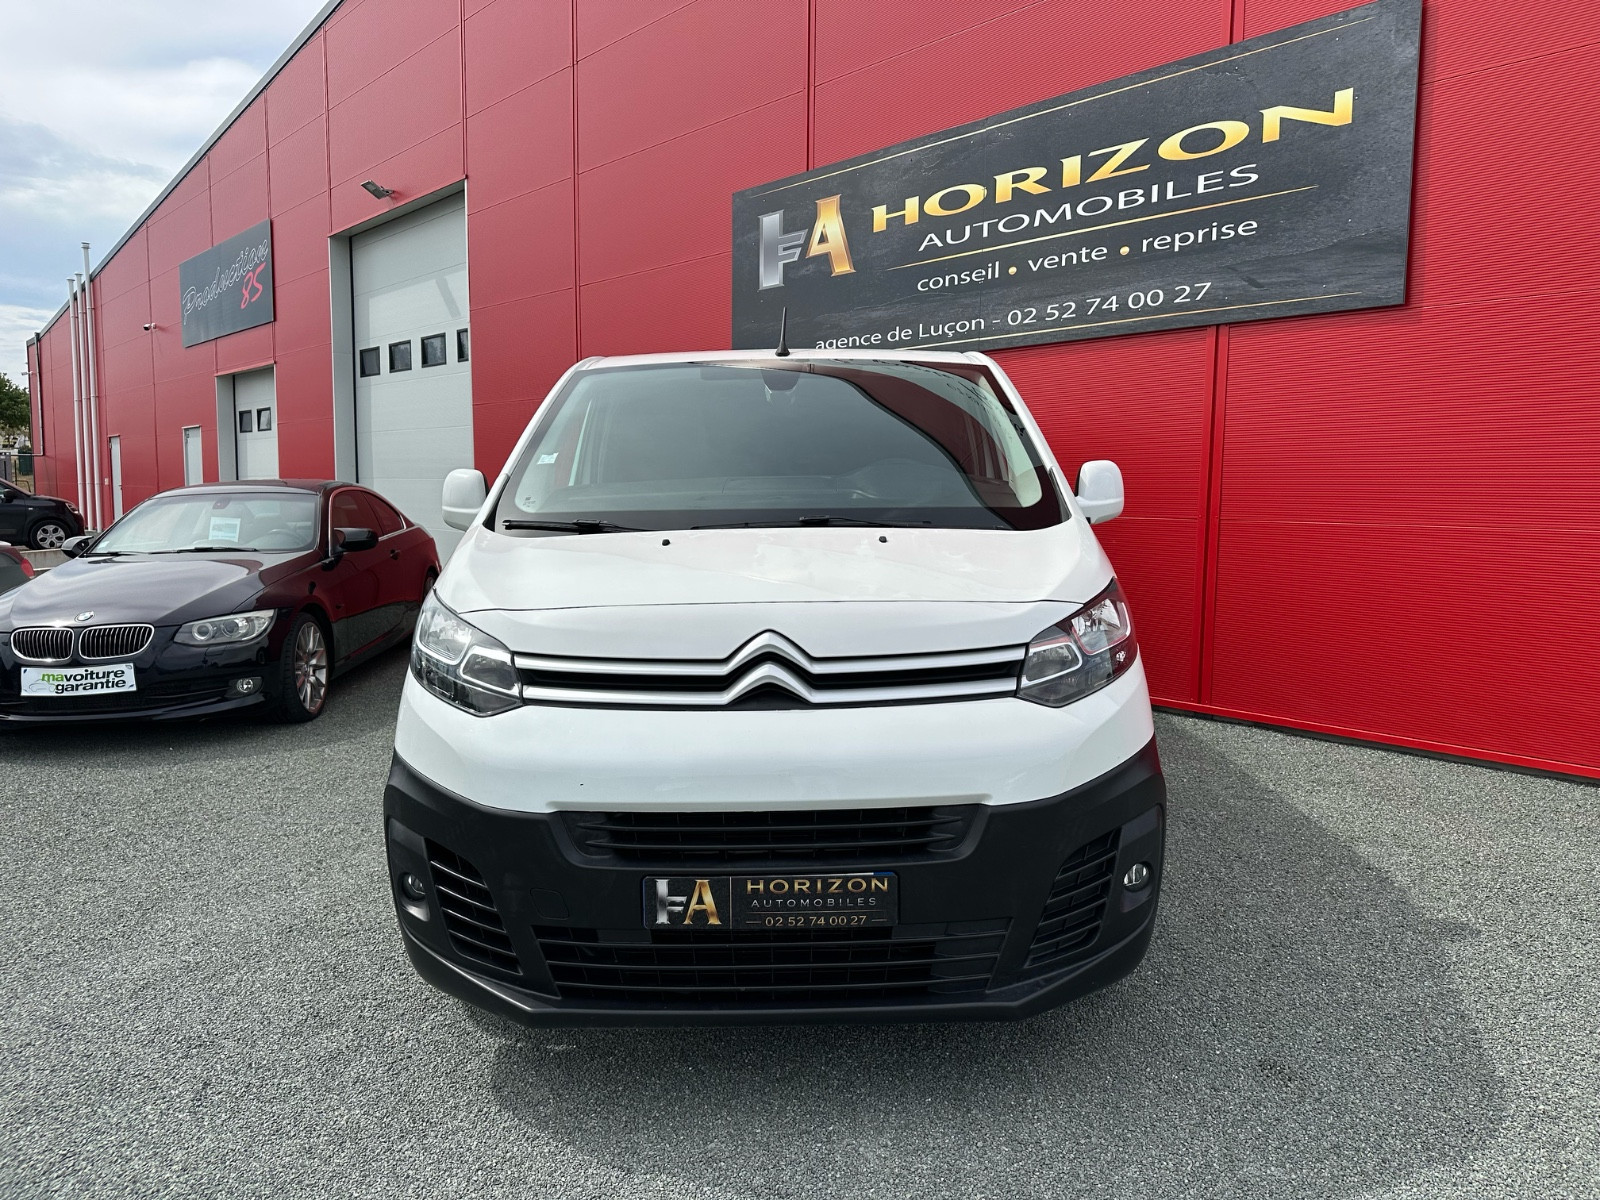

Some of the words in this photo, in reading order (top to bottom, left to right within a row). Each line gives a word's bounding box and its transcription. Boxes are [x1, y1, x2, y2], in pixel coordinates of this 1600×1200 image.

[871, 87, 1354, 233] HORIZON
[918, 163, 1259, 252] AUTOMOBILES
[182, 239, 269, 326] Production
[917, 260, 1000, 292] conseil
[1027, 245, 1108, 272] vente
[1141, 220, 1259, 252] reprise
[240, 262, 267, 310] 85
[815, 331, 882, 350] agence
[887, 326, 913, 342] de
[918, 317, 985, 338] Luçon
[1007, 307, 1037, 326] 02
[1045, 301, 1076, 321] 52
[1086, 295, 1120, 316] 74
[1127, 289, 1164, 309] 00
[1173, 281, 1212, 304] 27
[55, 678, 127, 694] garantie
[746, 877, 889, 895] HORIZON
[751, 897, 877, 908] AUTOMOBILES
[765, 916, 783, 927] 02
[788, 916, 804, 927] 52
[809, 916, 826, 927] 74
[829, 915, 847, 926] 00
[850, 915, 868, 926] 27
